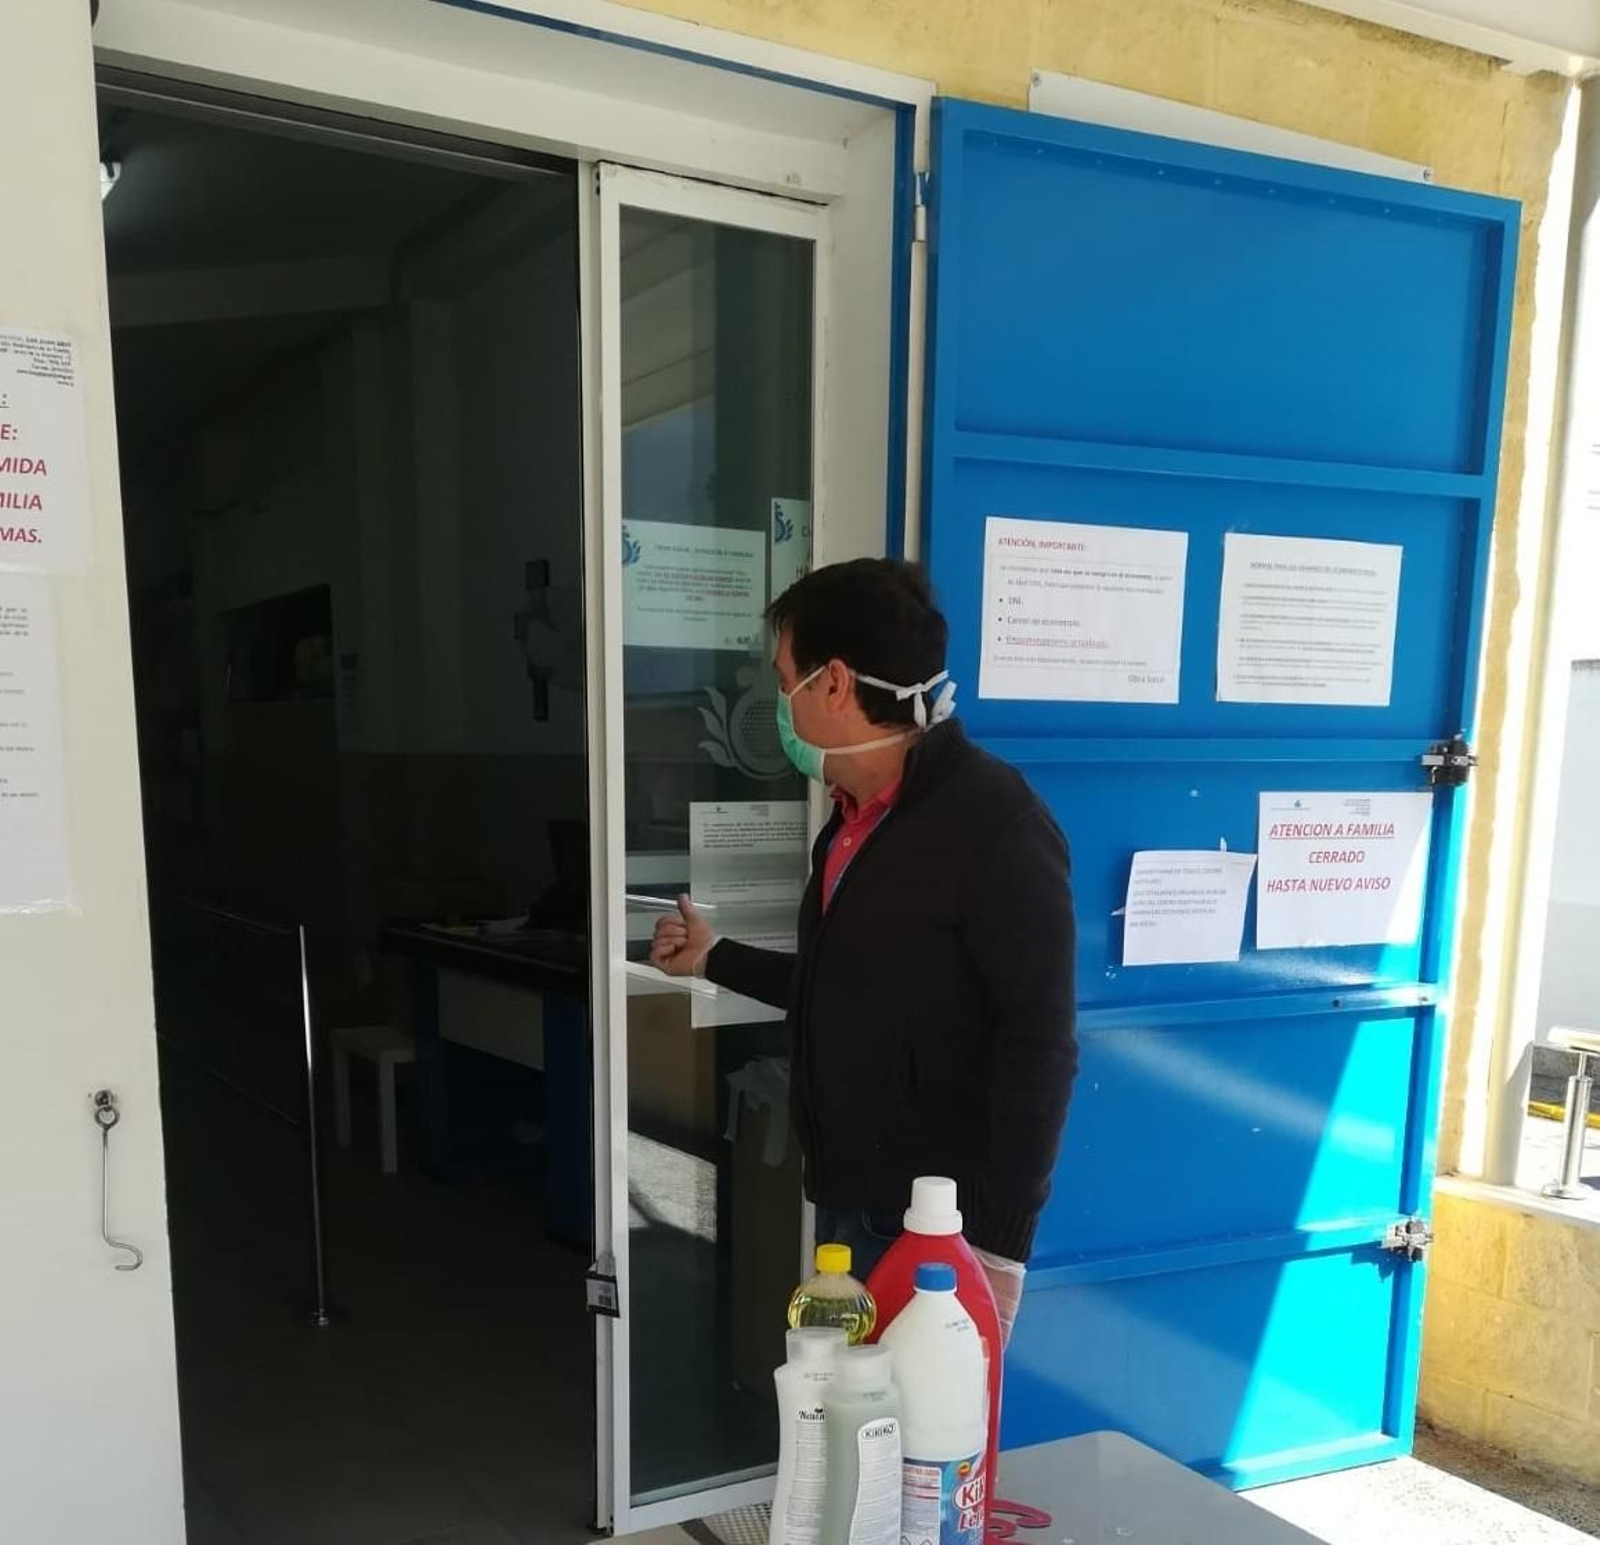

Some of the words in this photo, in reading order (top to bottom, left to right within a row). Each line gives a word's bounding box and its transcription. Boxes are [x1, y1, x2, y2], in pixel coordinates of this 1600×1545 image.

[1269, 823, 1333, 838] ATENCION
[1334, 823, 1345, 837] A
[1347, 822, 1395, 836] FAMILIA
[1308, 850, 1366, 865] CERRADO
[1266, 878, 1307, 893] HASTA
[1309, 877, 1352, 891] NUEVO
[1354, 876, 1392, 890] AVISO
